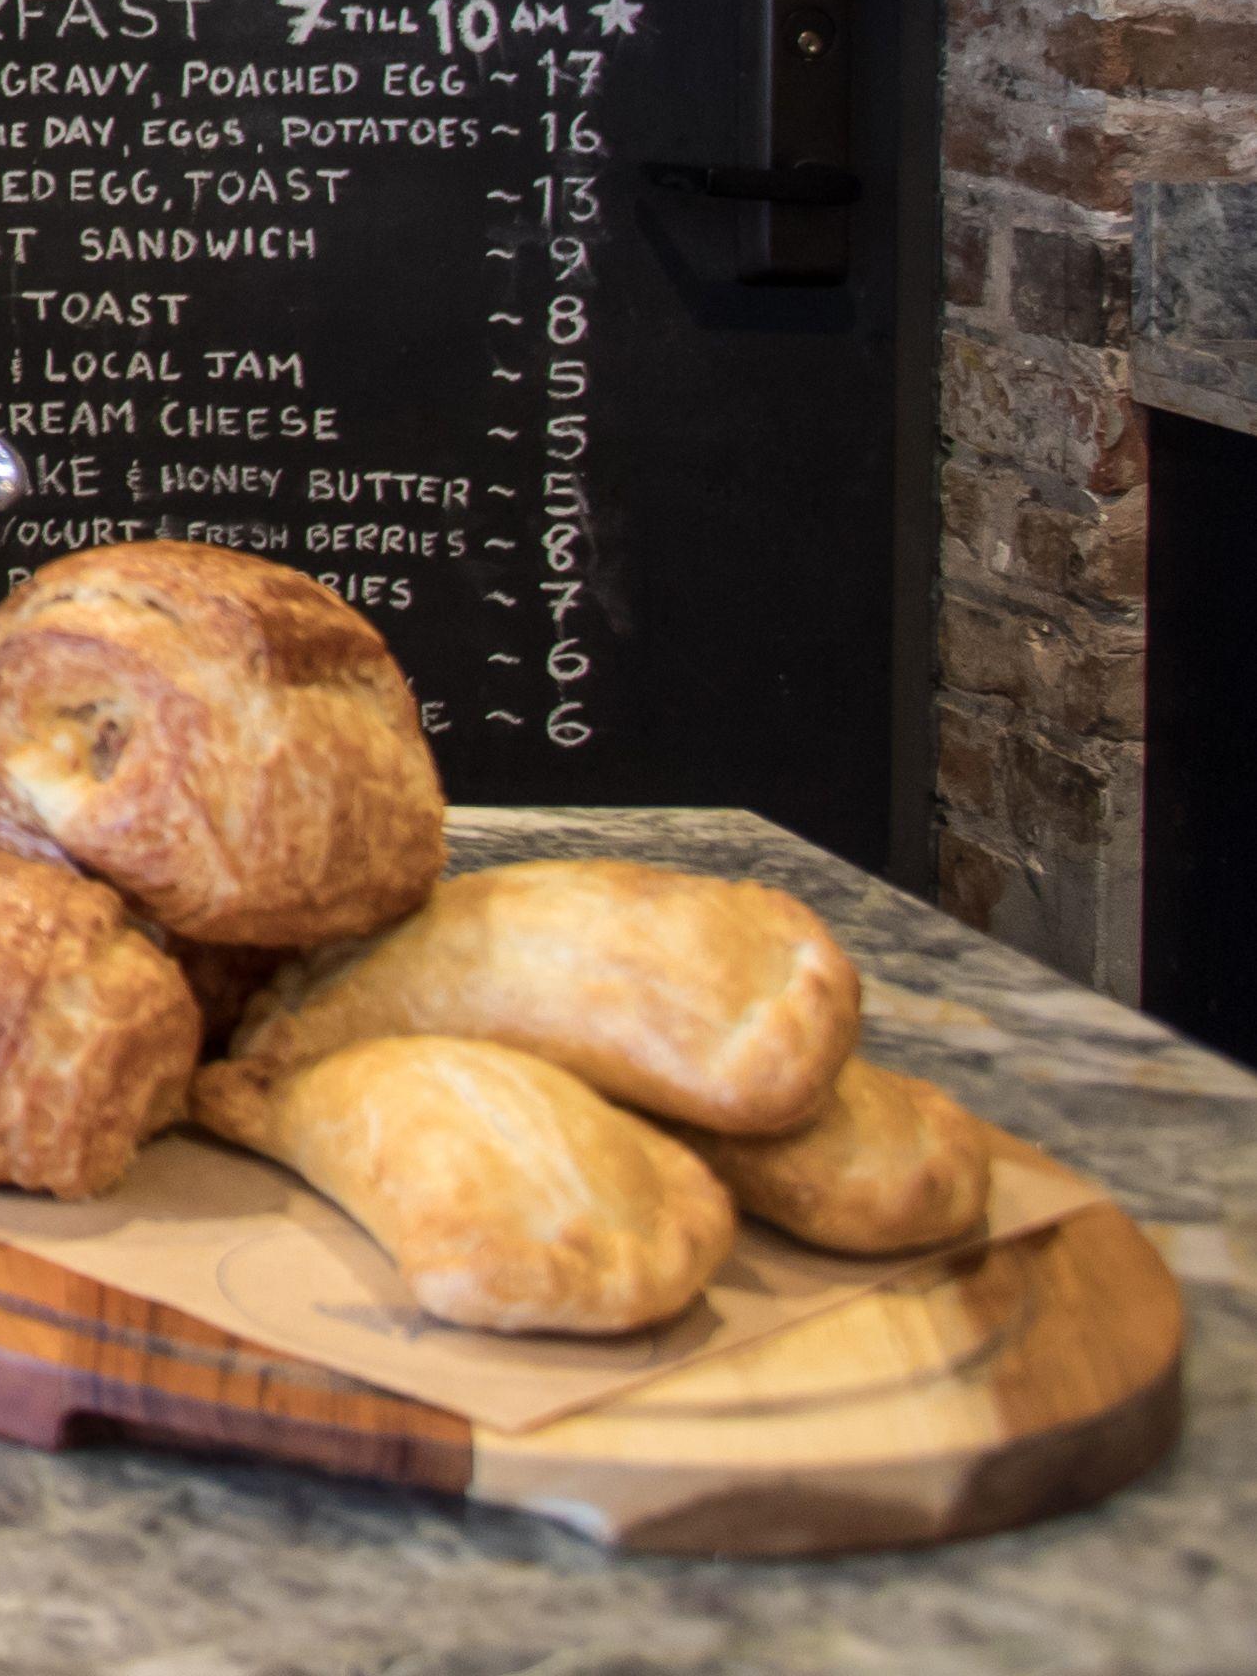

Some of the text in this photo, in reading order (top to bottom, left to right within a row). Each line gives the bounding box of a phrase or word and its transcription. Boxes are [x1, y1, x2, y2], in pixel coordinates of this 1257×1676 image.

[340, 6, 420, 35] TILL
[509, 0, 569, 36] AM
[181, 59, 359, 98] POACHED
[382, 62, 466, 97] EGG
[537, 48, 605, 97] 17
[282, 115, 479, 148] POTATOES
[539, 110, 601, 154] 16
[184, 168, 351, 206] TOAST
[533, 175, 598, 225] 13
[80, 226, 315, 262] SANDWICH
[550, 237, 587, 281] 9
[22, 291, 190, 327] TOAST
[548, 295, 587, 344] 8
[45, 350, 180, 383] LOCAL
[204, 350, 305, 389] JAM
[548, 360, 587, 399] 5
[160, 402, 339, 441] CHEESE
[547, 414, 587, 460] 5
[161, 463, 283, 497] HONEY
[308, 468, 470, 508] BUTTER
[543, 473, 585, 517] 5
[306, 523, 467, 558] BERRIES
[542, 523, 580, 571] 8
[317, 572, 413, 611] RIES
[540, 582, 582, 622] 7
[547, 638, 590, 681] 6
[547, 702, 592, 747] 6
